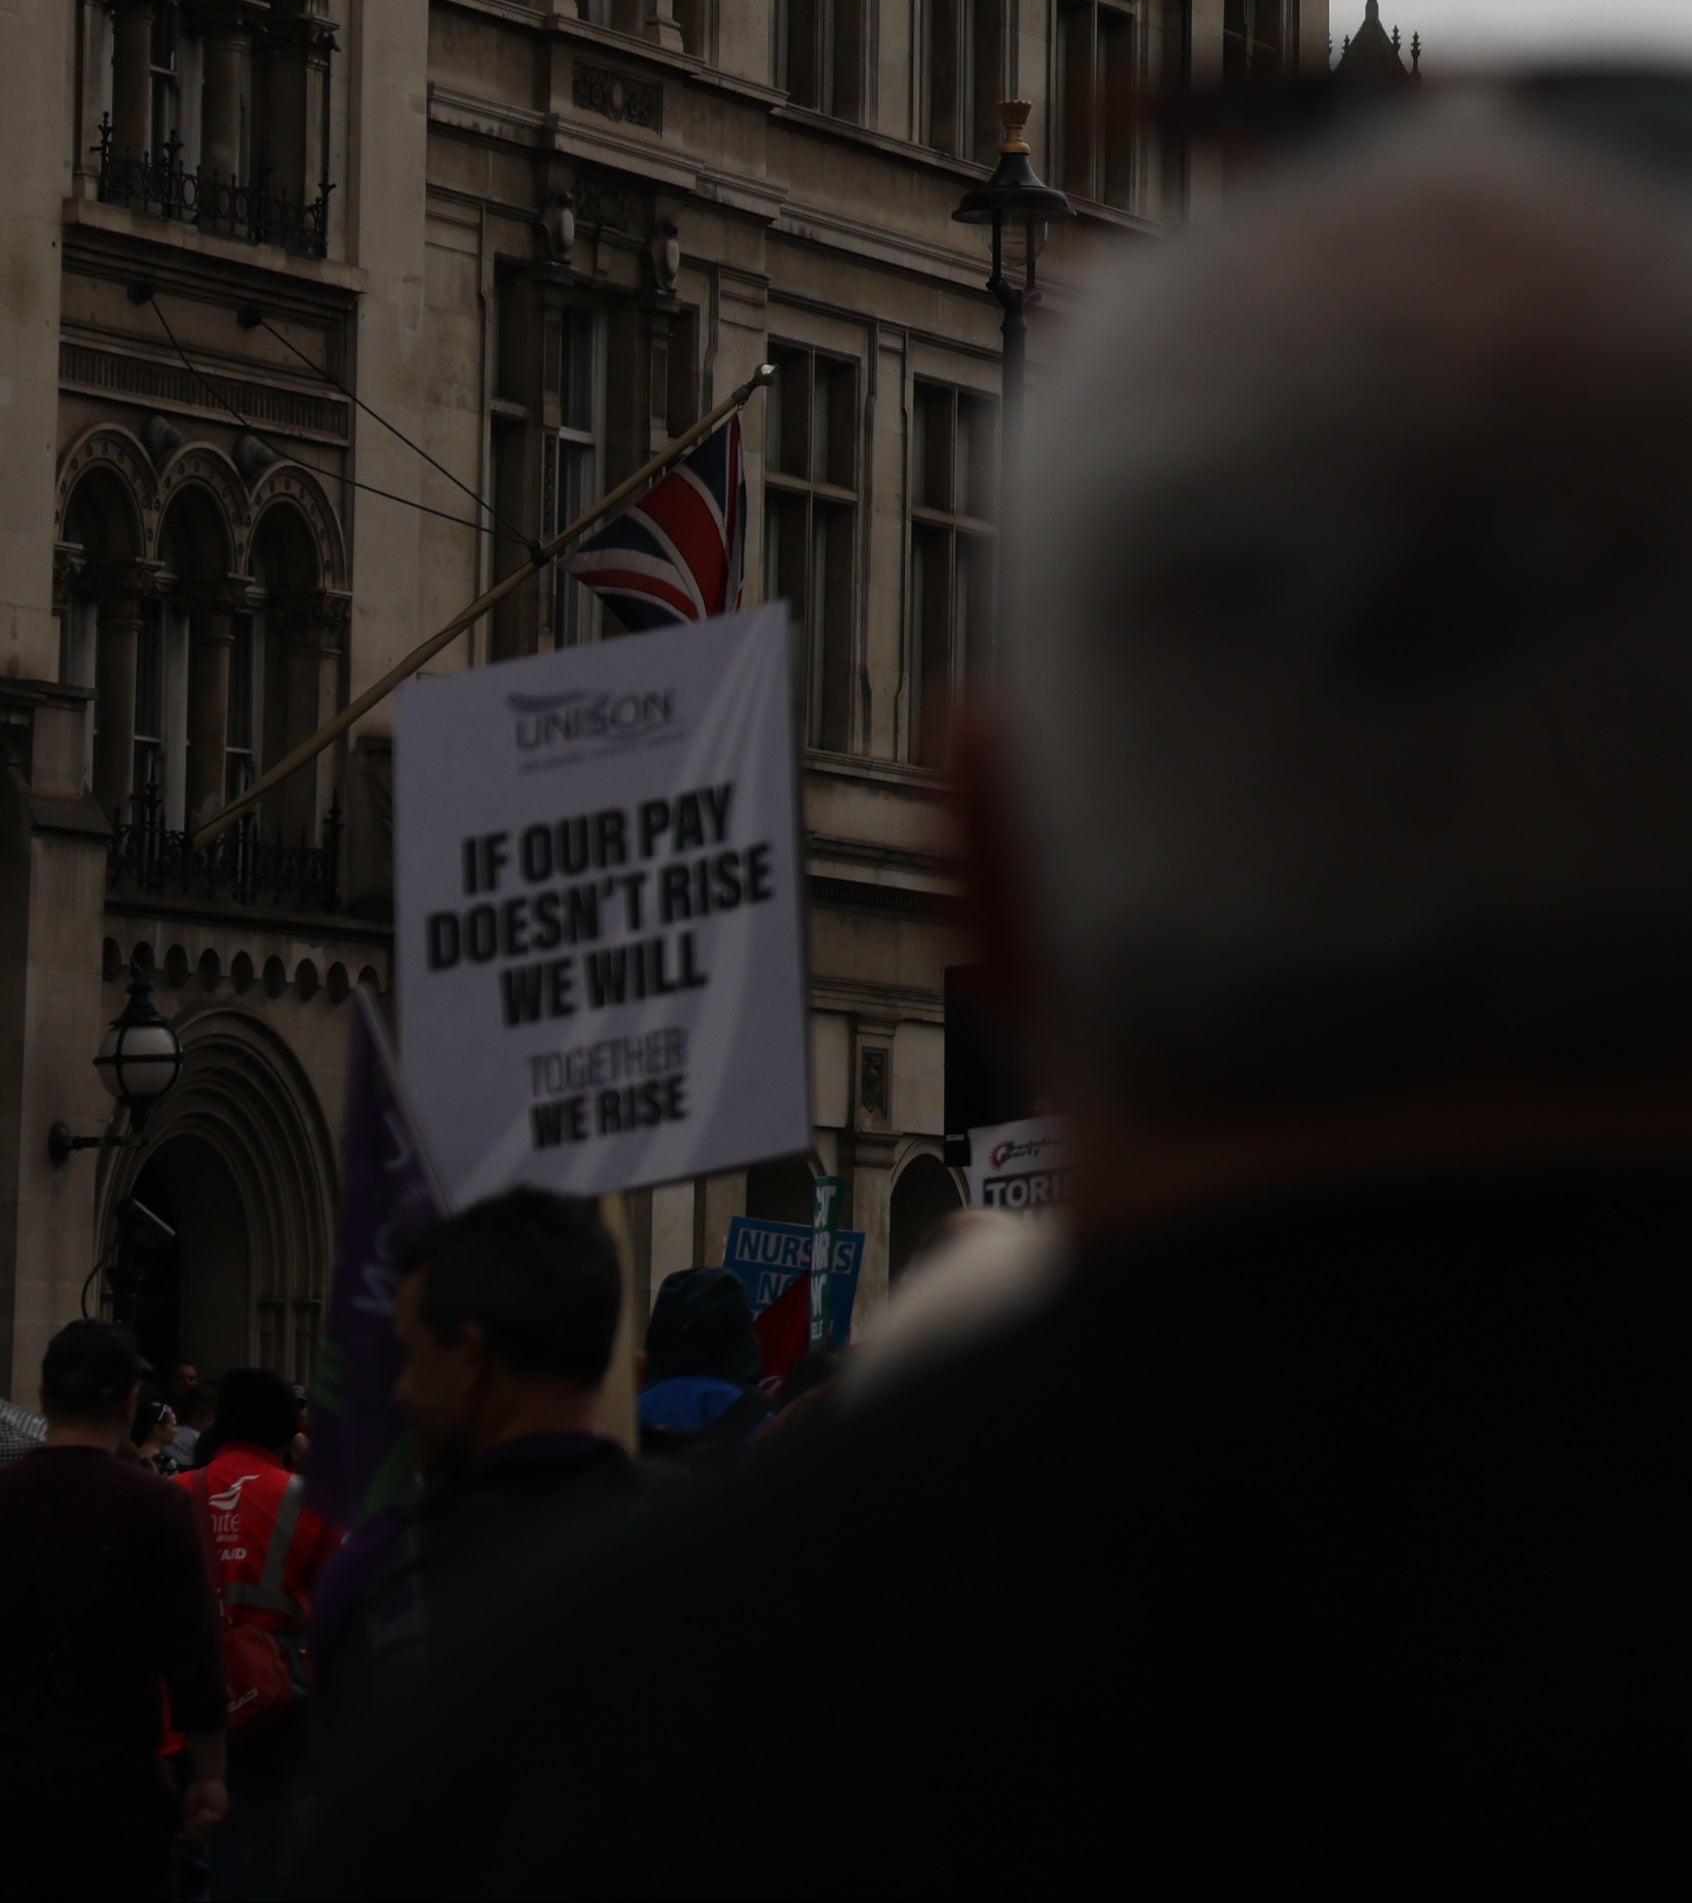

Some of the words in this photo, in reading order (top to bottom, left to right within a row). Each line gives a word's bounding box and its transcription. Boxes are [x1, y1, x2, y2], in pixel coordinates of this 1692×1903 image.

[515, 688, 675, 753] UNISON
[462, 831, 509, 895] IF
[521, 808, 627, 884] OUR
[638, 782, 732, 860] PAY
[427, 872, 648, 973] DOESN'T
[659, 841, 774, 924] RISE
[501, 958, 575, 1027] WE
[587, 932, 708, 1009] WILL
[530, 1025, 690, 1096] TOGETHER
[531, 1097, 588, 1149] WE
[599, 1076, 687, 1135] RISE
[735, 1228, 856, 1275] NURSS
